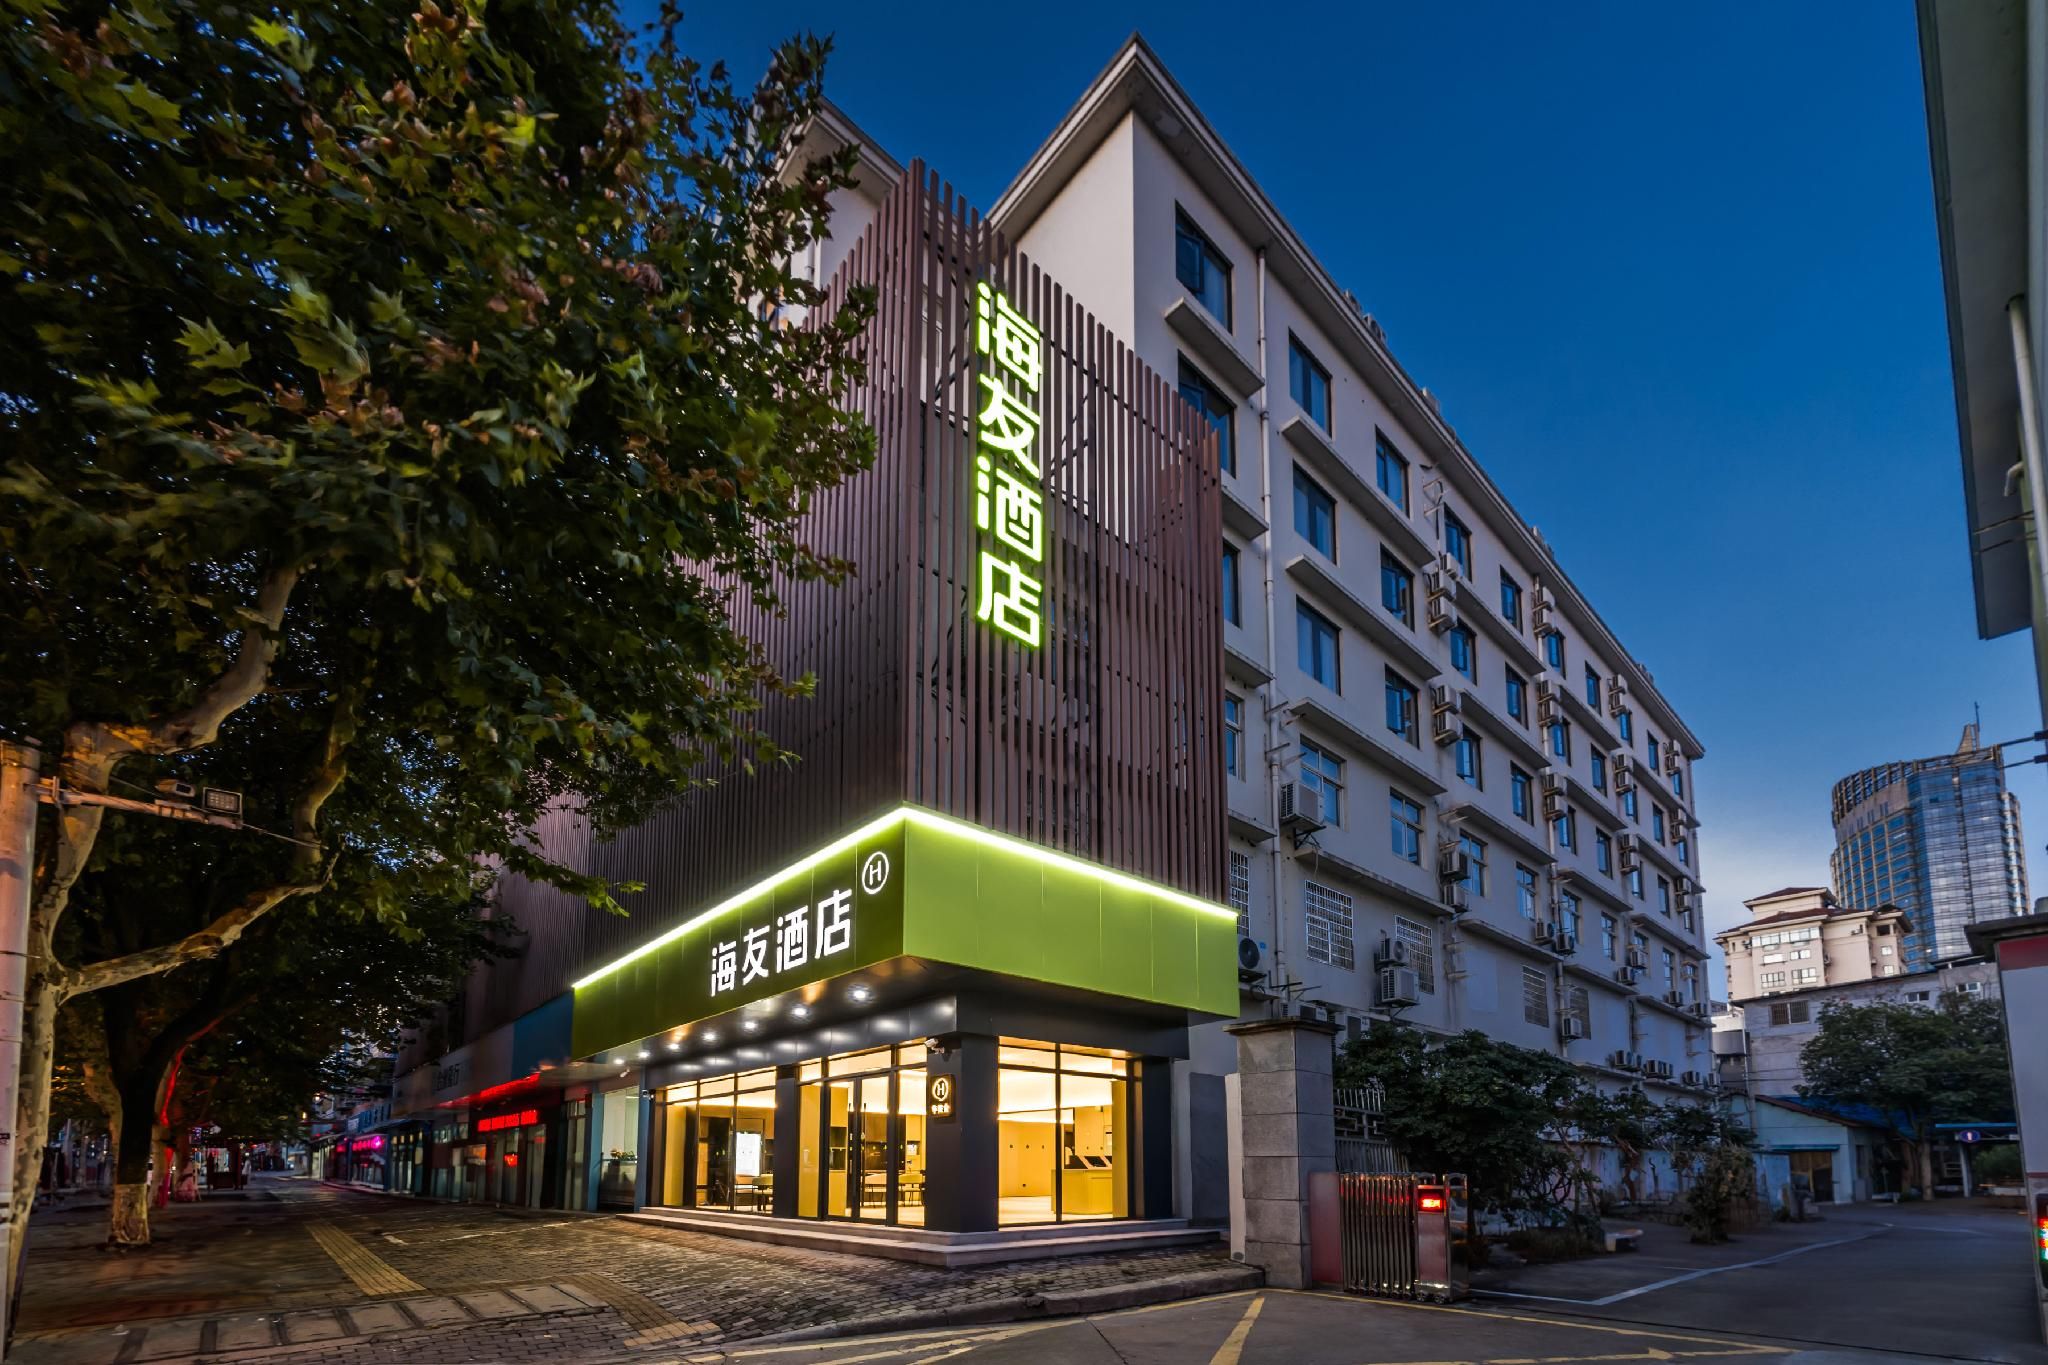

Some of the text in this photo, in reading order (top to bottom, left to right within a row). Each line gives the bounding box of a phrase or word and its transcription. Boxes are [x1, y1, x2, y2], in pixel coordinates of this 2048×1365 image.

[977, 282, 1043, 647] 海友酒店
[711, 889, 852, 997] 海友酒店
